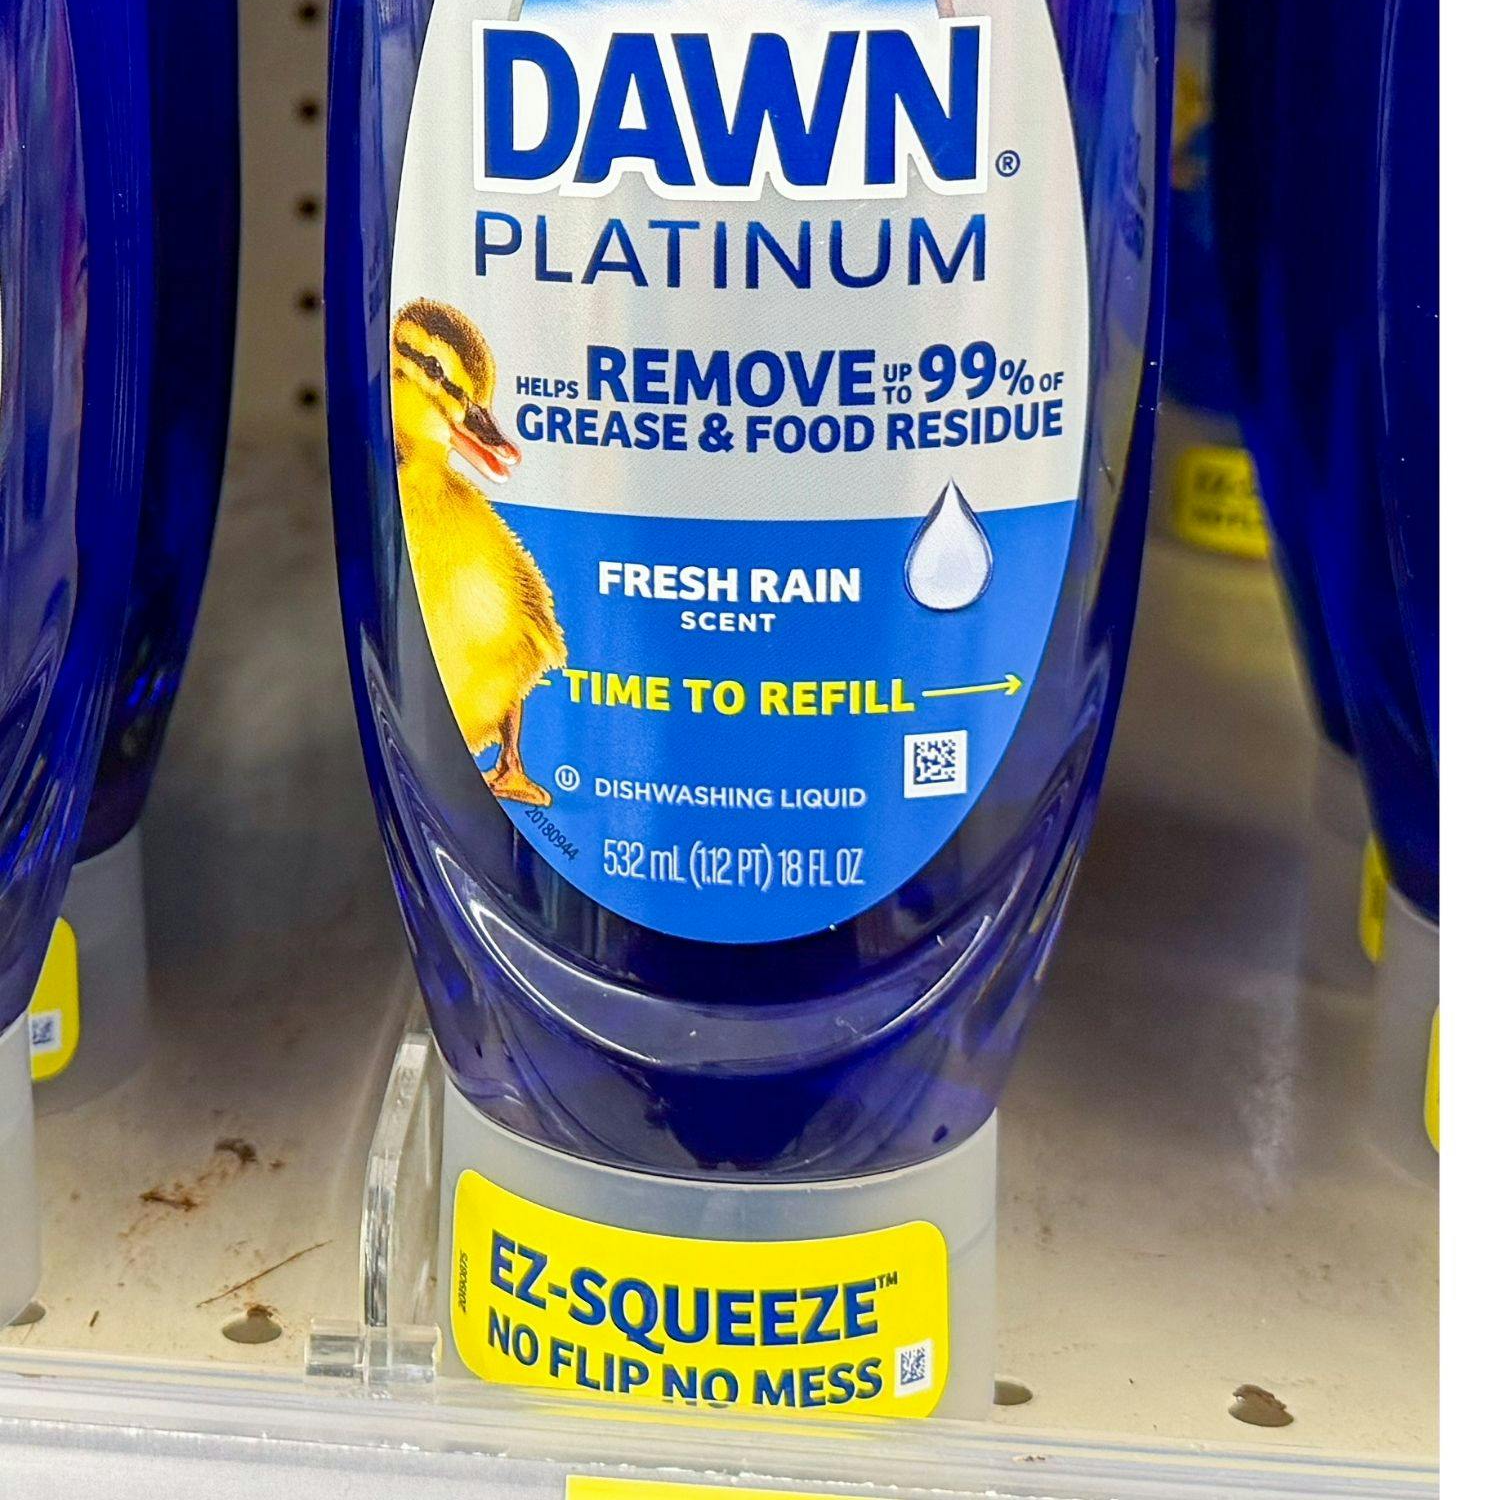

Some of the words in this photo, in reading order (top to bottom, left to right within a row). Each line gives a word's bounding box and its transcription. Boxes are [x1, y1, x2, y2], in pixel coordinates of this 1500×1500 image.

[473, 210, 986, 289] PLATINUM
[516, 374, 580, 400] HELPS
[587, 345, 875, 407] REMOVE
[882, 362, 912, 382] UP
[918, 342, 1035, 398] 99%
[1039, 371, 1064, 391] OF
[881, 384, 912, 405] TO
[516, 406, 687, 452] GREASE
[703, 412, 734, 452] &
[747, 412, 874, 453] FOOD
[887, 400, 1063, 450] RESIDUE
[598, 560, 738, 602] FRESH
[750, 567, 861, 603] RAIN
[680, 611, 776, 633] SCENT
[562, 668, 670, 712] TIME
[683, 678, 745, 715] TO
[759, 677, 915, 716] REFILL
[595, 777, 773, 808] DISHWASHING
[781, 787, 867, 808] LIQUID
[524, 807, 579, 862] 20180944
[604, 839, 647, 879] 532
[650, 845, 685, 884] mL
[738, 843, 773, 892] PT)
[778, 849, 802, 887] 18
[809, 849, 833, 887] FL
[839, 848, 866, 886] OZ
[487, 1306, 539, 1366] NO
[549, 1336, 649, 1394] FLIP
[661, 1363, 740, 1408] NO
[752, 1357, 884, 1409] MESS
